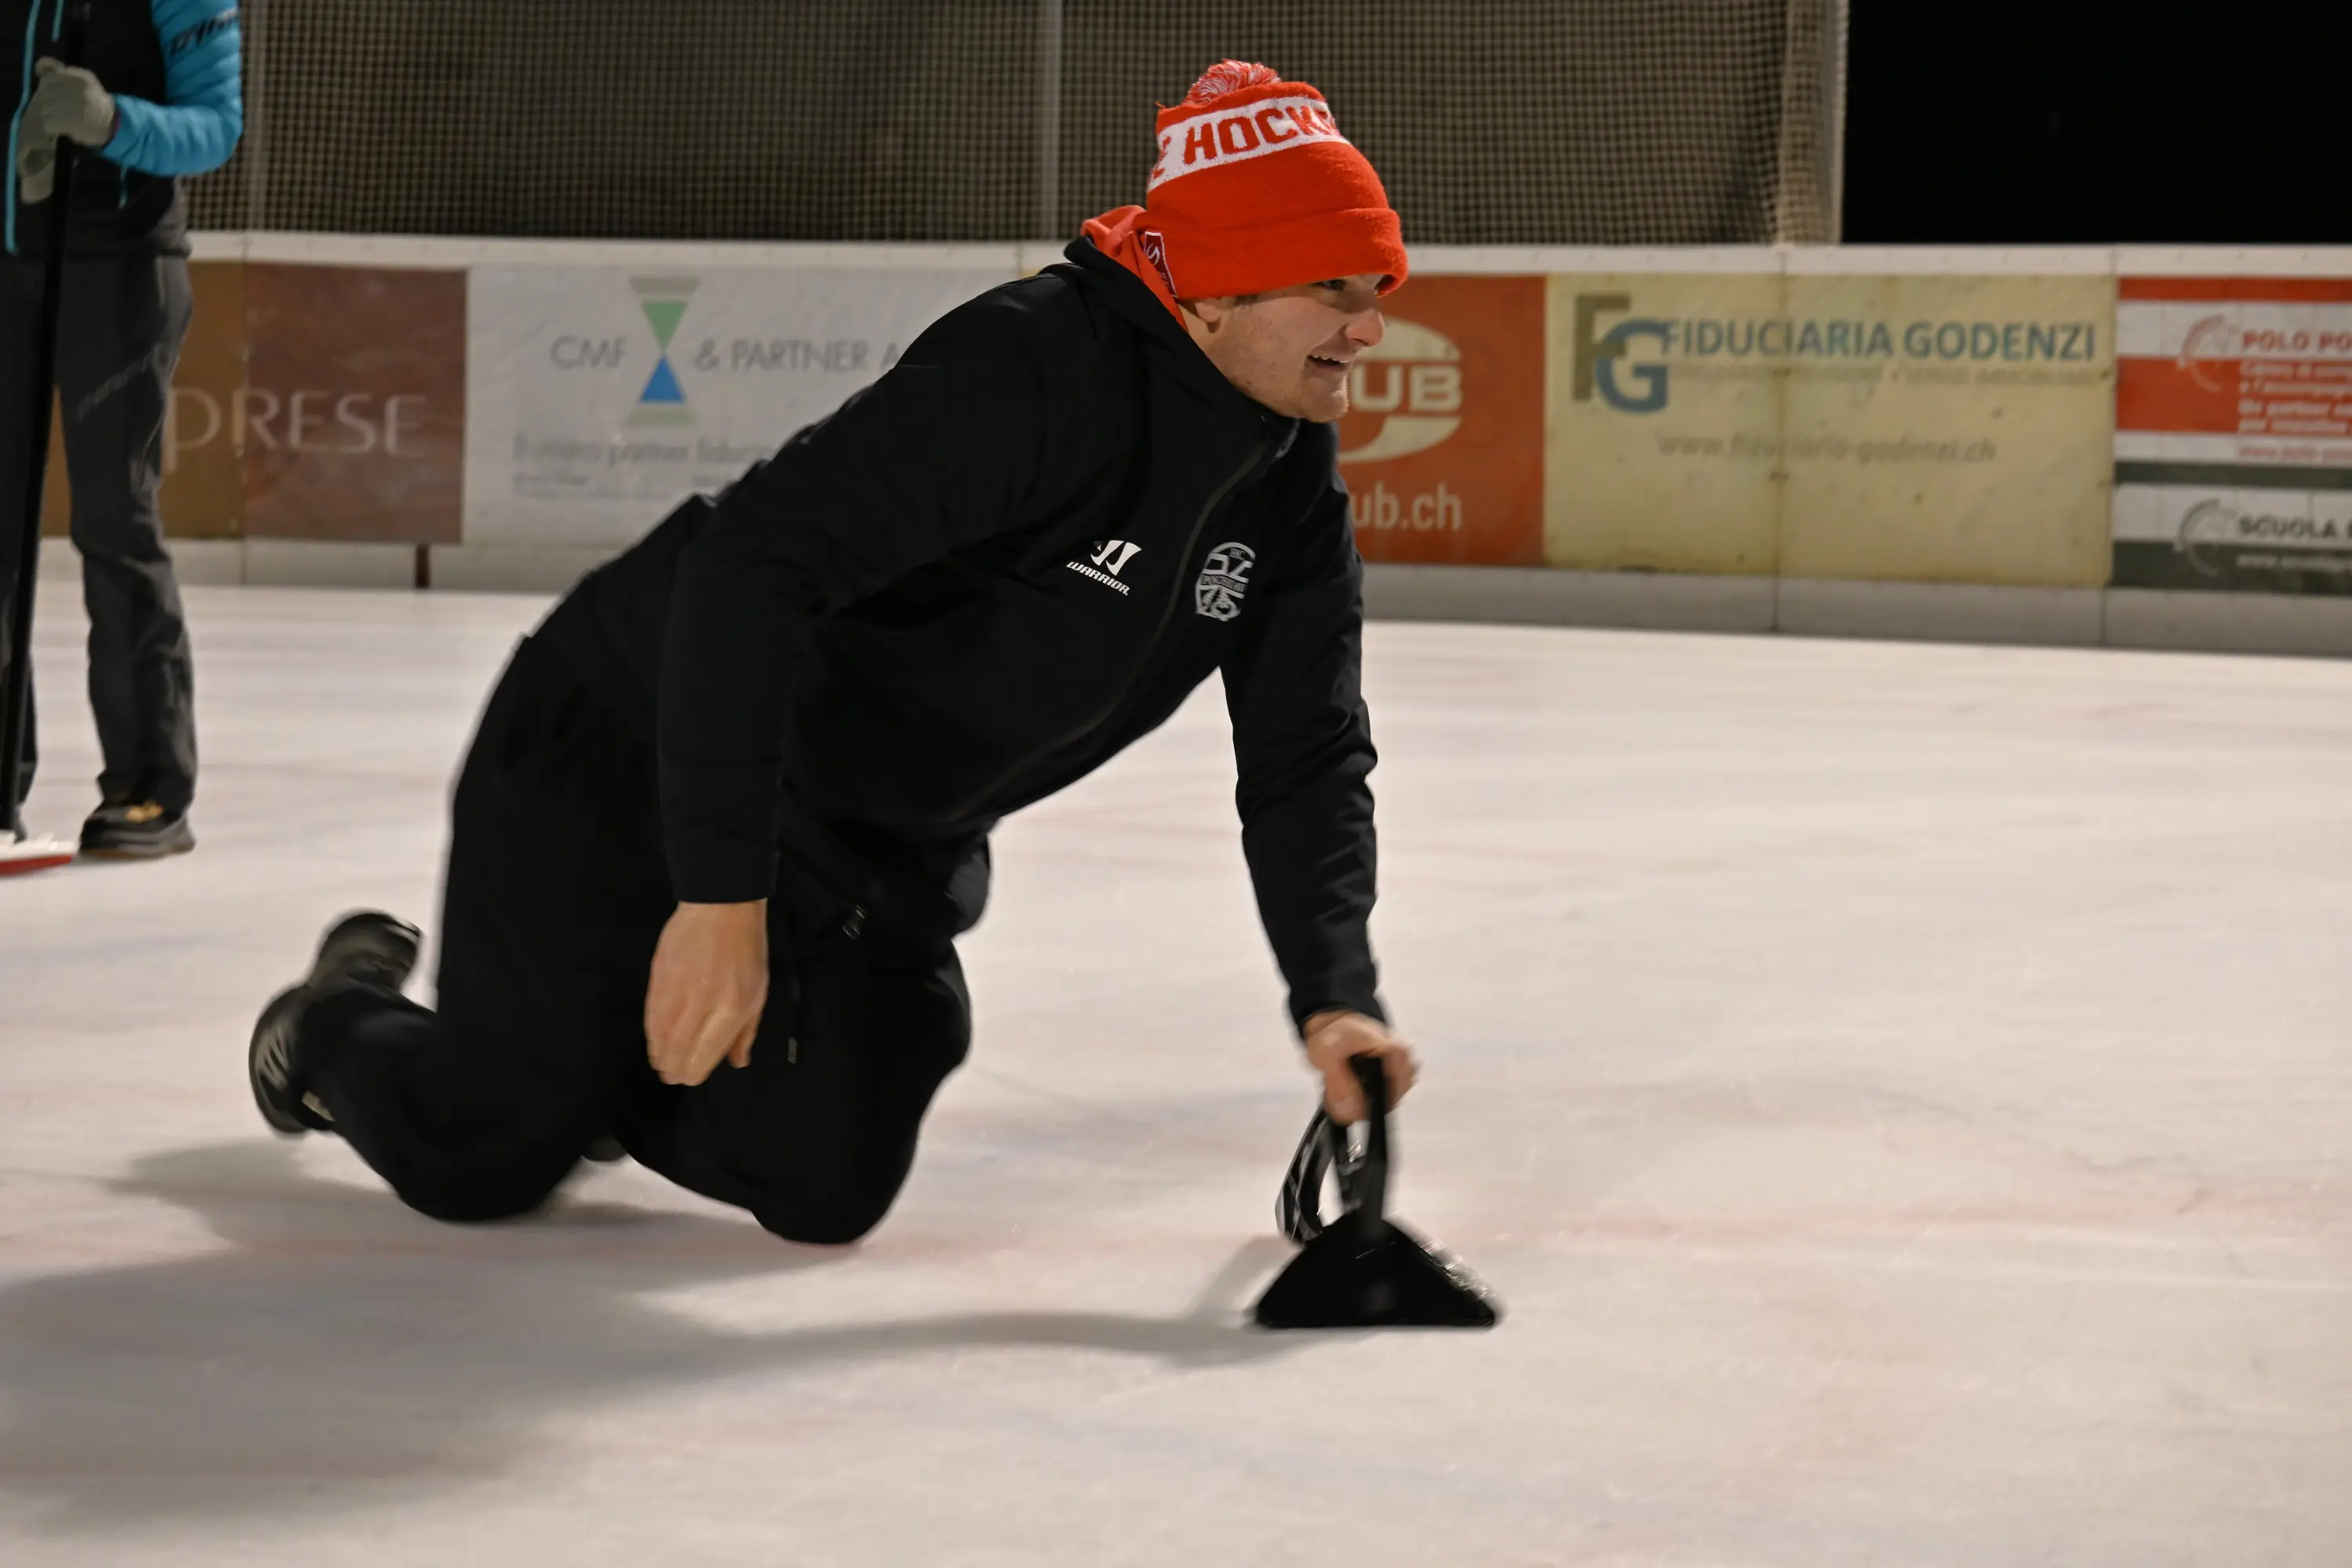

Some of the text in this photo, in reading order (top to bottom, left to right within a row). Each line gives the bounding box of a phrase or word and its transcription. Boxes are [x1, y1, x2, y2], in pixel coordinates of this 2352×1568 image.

[550, 335, 627, 370] CMF
[691, 337, 720, 372] &
[730, 339, 870, 372] PARTNER
[1660, 318, 2095, 361] FIDUCIARIA GODENZI
[2242, 328, 2310, 350] POLO
[165, 387, 429, 472] PRESE
[2238, 514, 2339, 538] SCUOLA
[1065, 561, 1131, 596] WARRIOR
